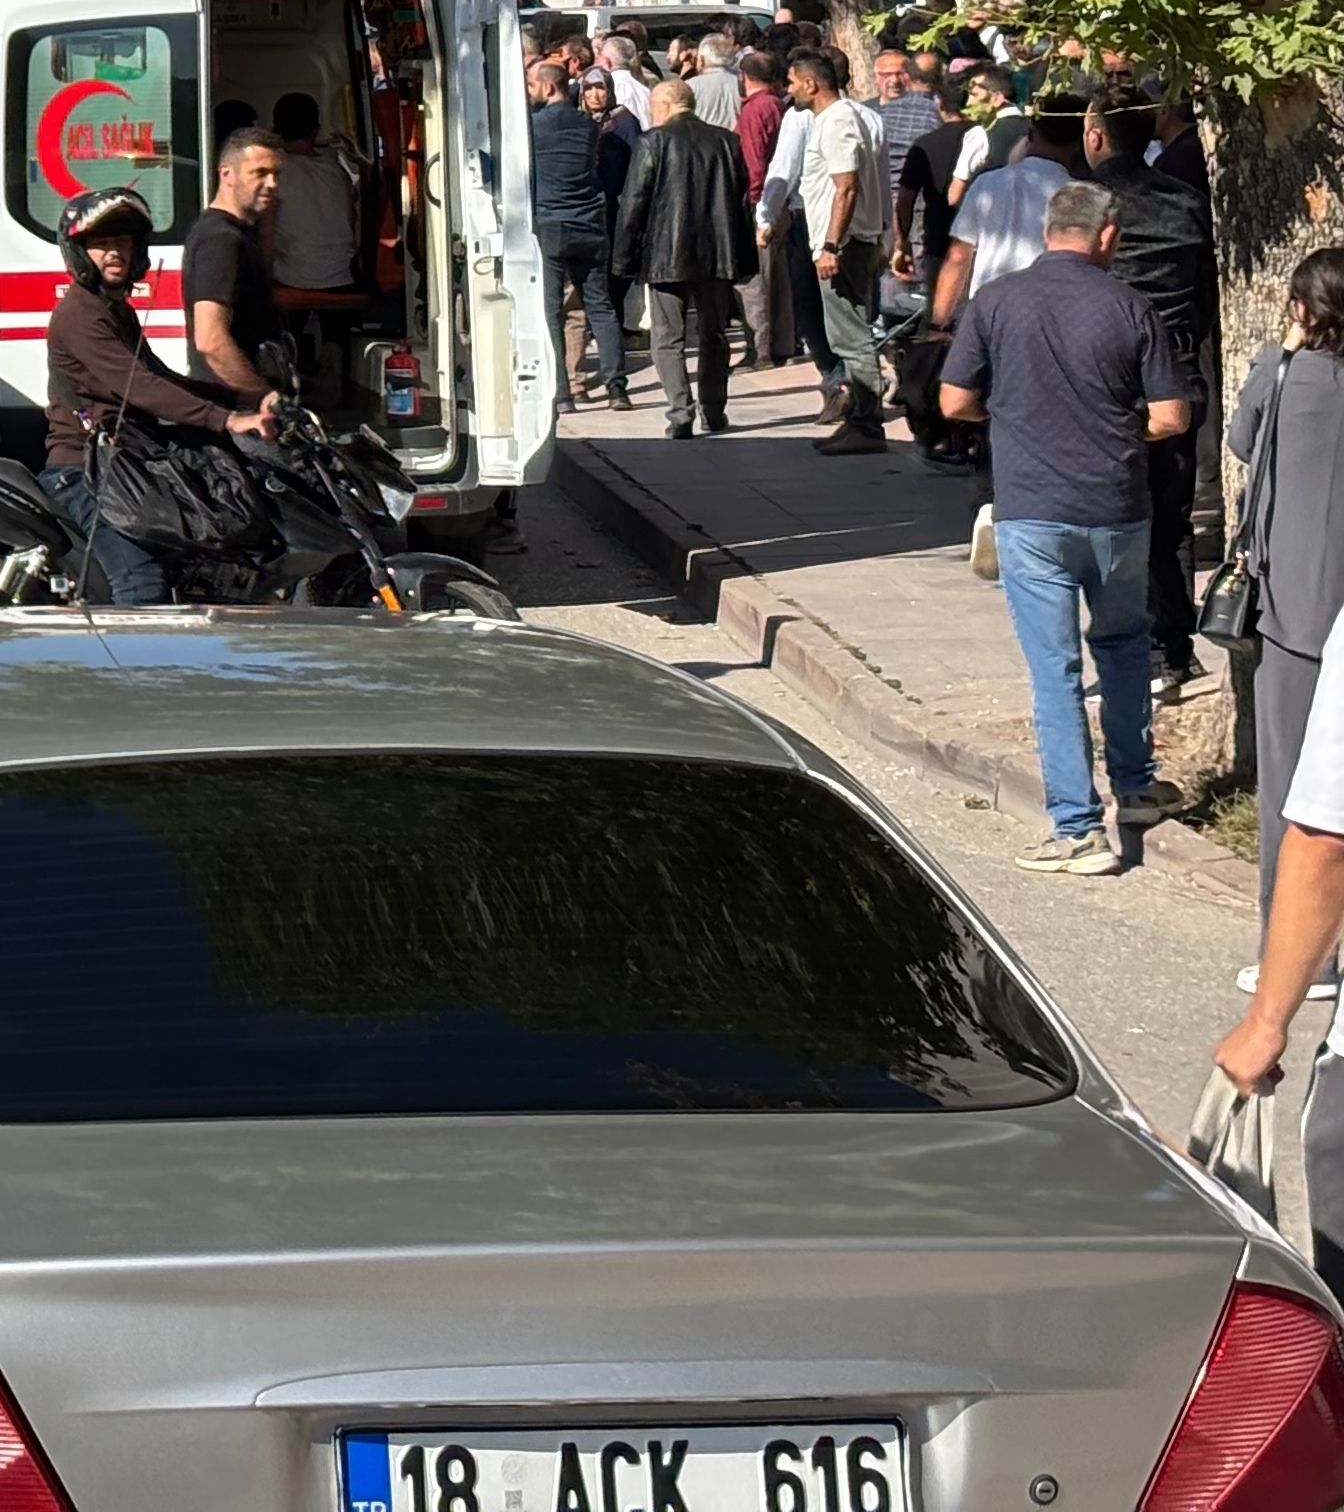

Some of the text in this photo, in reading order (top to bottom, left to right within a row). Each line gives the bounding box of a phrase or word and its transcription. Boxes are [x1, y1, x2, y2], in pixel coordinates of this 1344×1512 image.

[400, 1436, 890, 1512] 18 ACK 616
